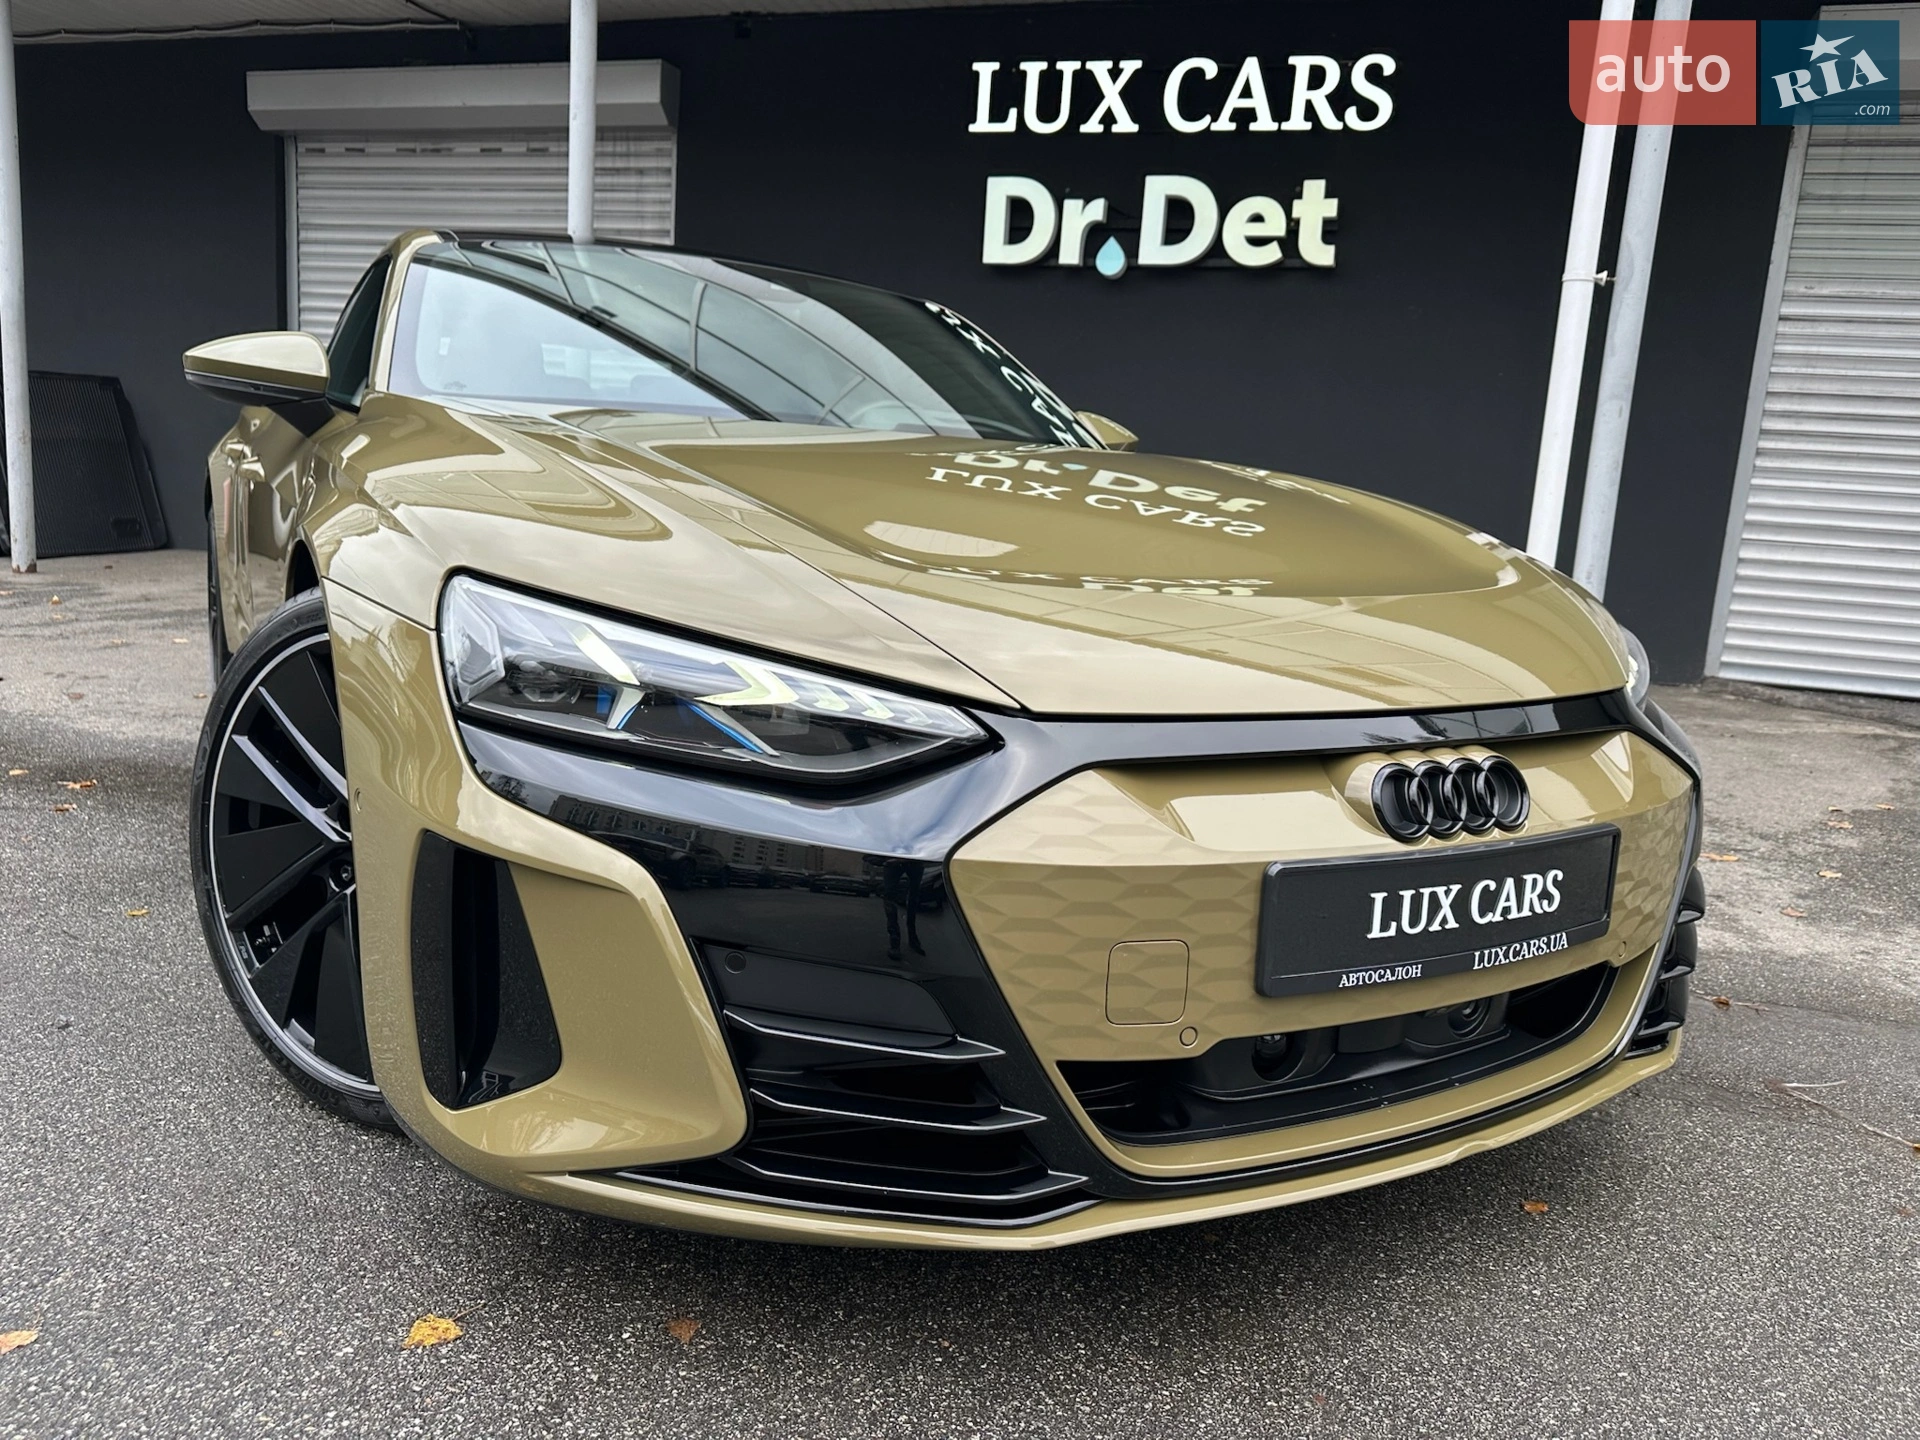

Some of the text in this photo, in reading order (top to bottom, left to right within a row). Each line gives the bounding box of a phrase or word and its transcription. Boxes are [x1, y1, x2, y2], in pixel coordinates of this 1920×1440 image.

[967, 53, 1397, 134] LUX CARS
[1366, 868, 1564, 940] LUX CARS
[1338, 964, 1423, 988] АВТОСАЛОН
[1472, 931, 1569, 970] LUX.CARS.UA
